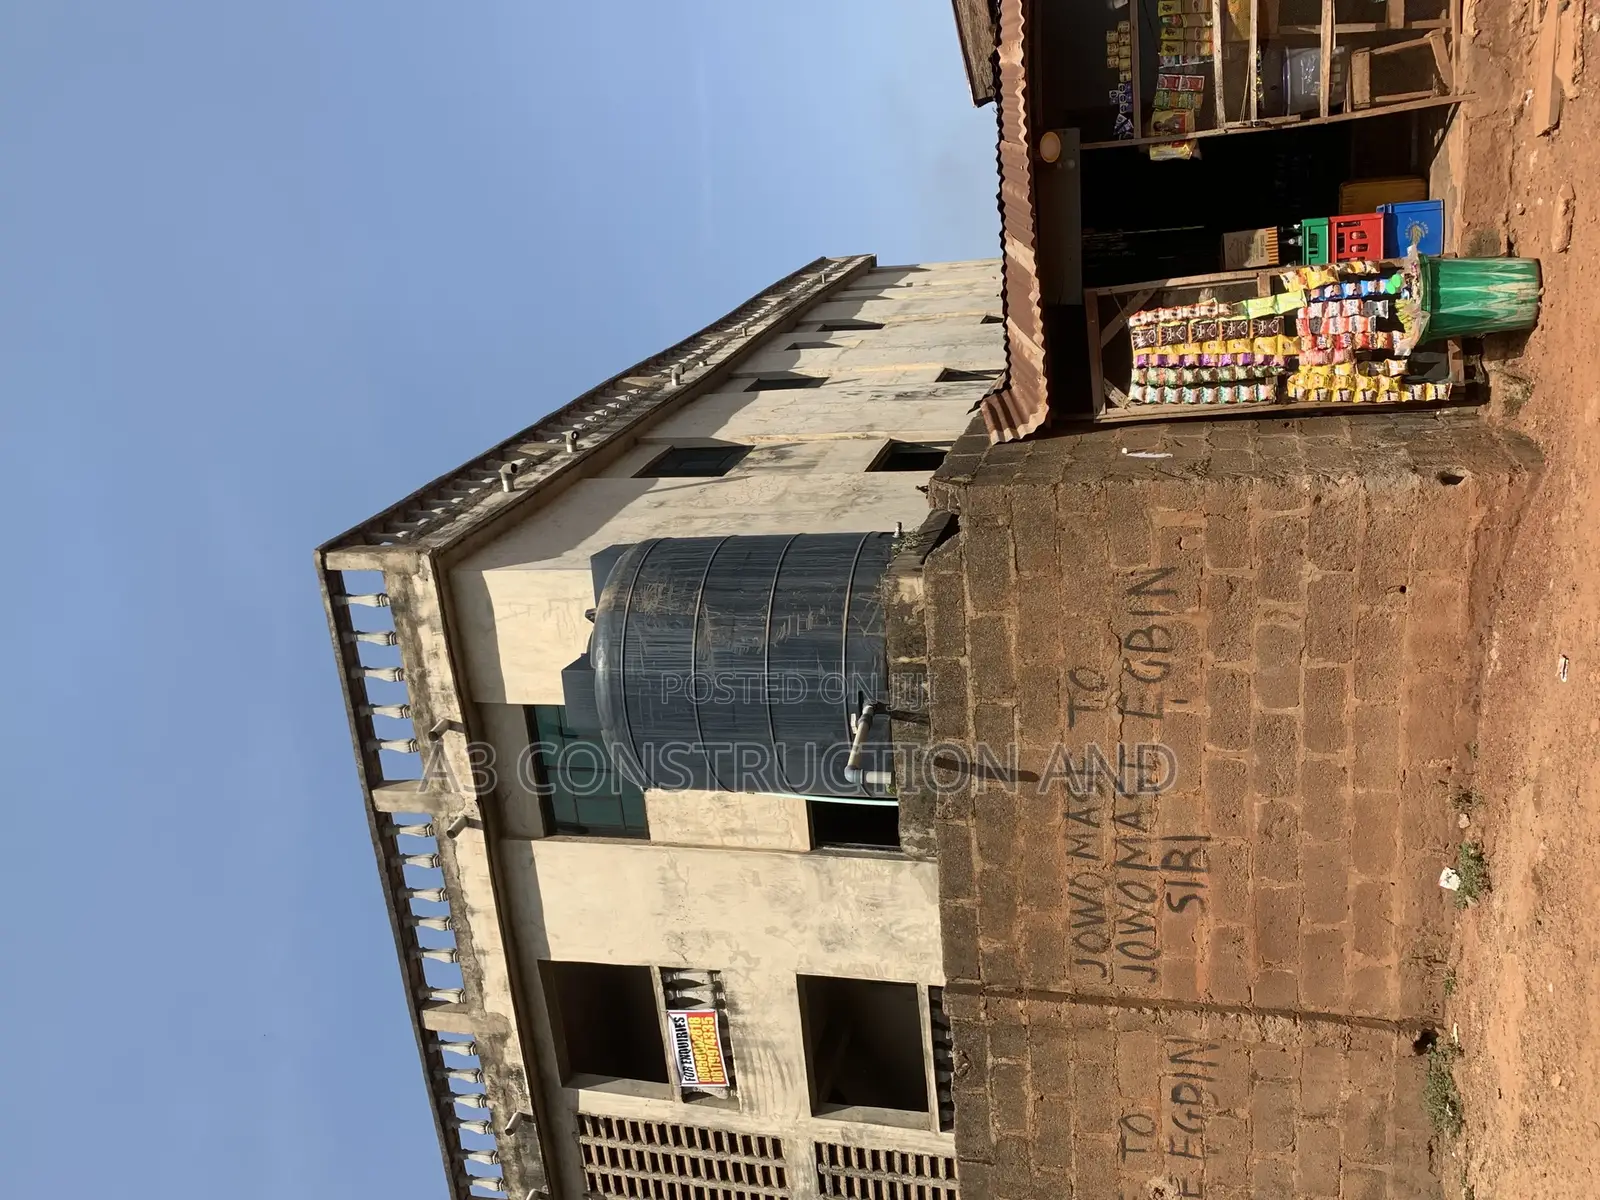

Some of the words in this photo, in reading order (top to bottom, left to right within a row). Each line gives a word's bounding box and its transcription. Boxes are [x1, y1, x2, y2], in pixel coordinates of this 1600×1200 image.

[1067, 665, 1108, 730] TO
[673, 1017, 692, 1065] ENQUIRIES
[683, 1066, 696, 1082] FOR
[1117, 1113, 1157, 1164] TO
